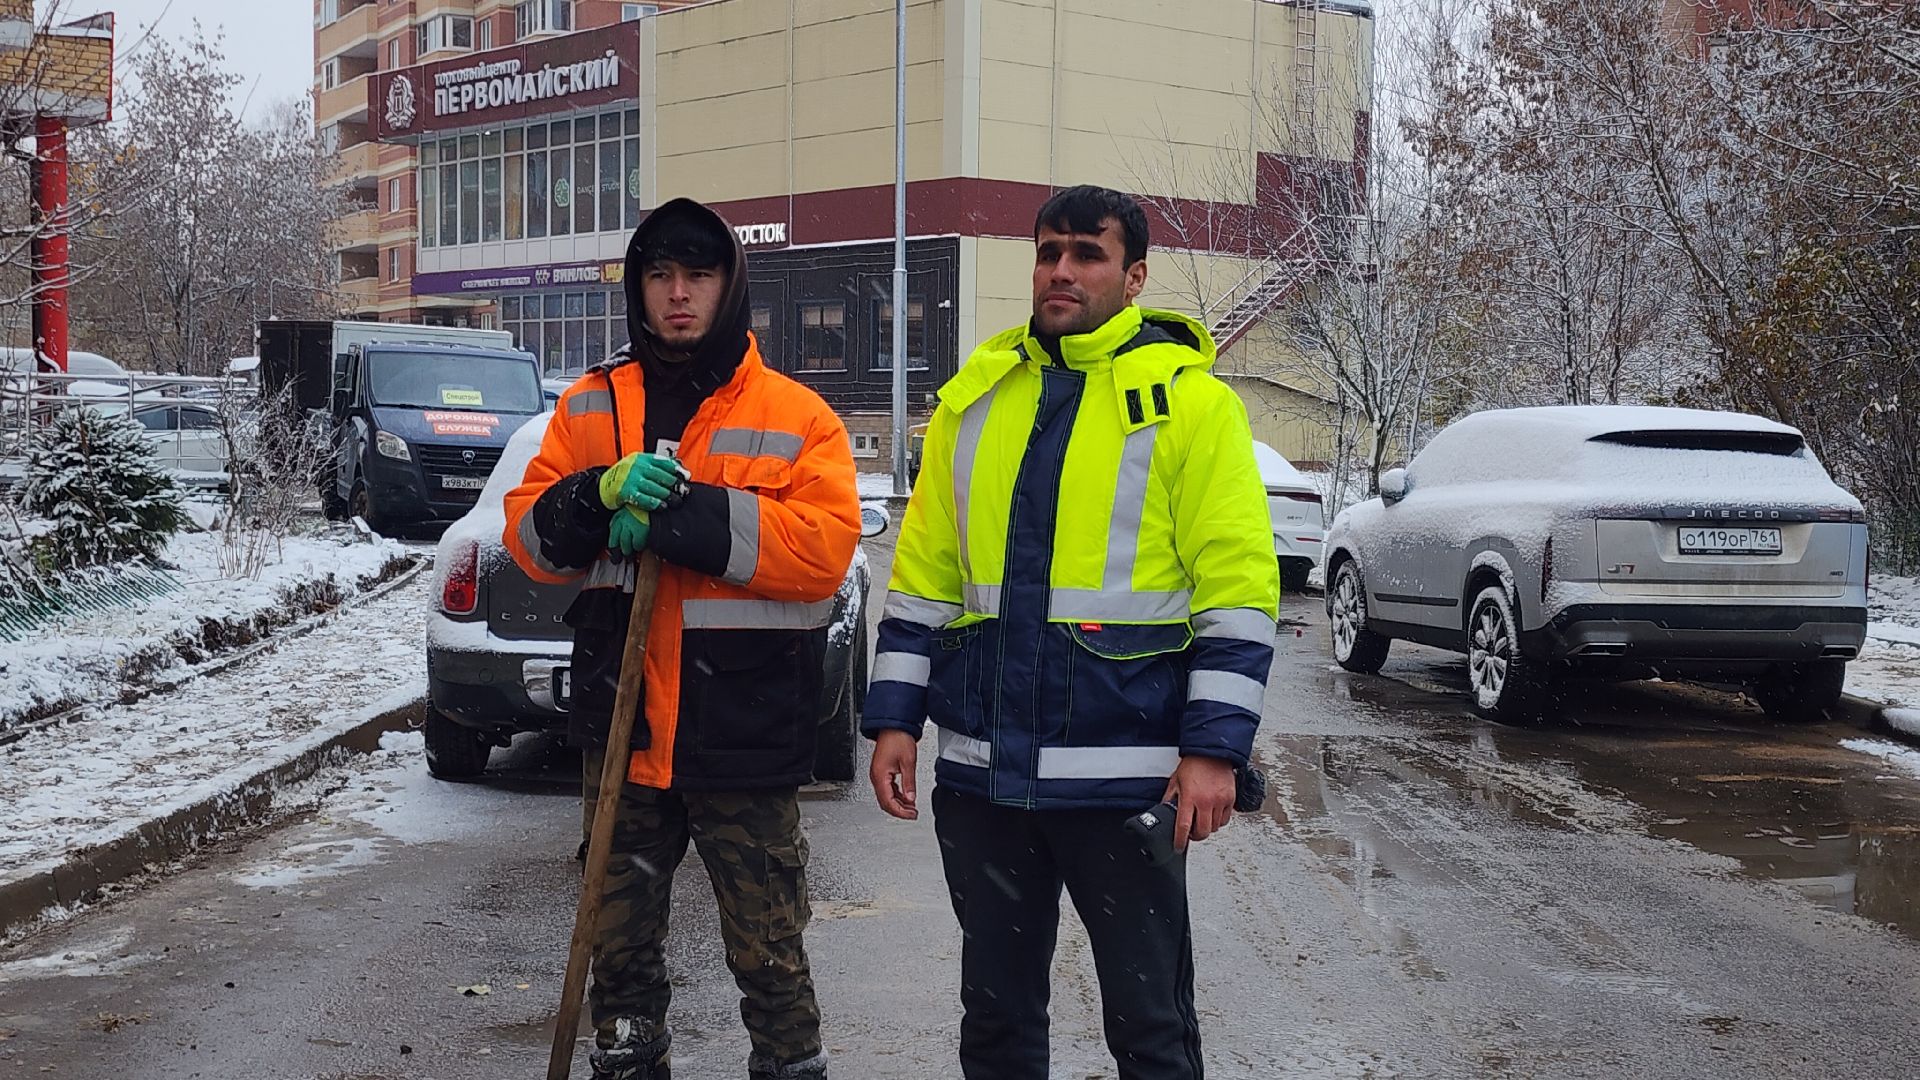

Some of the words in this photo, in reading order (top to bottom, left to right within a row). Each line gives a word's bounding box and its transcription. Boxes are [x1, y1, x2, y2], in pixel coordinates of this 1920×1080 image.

[434, 49, 620, 117] ПЕРВОМАЙСКИЙ
[733, 222, 787, 246] ОСТОК
[426, 413, 499, 424] ДОРОЖНАЯ
[437, 424, 491, 434] СЛУЖБА
[1687, 509, 1780, 519] JAECOO
[1607, 562, 1636, 575] J7
[501, 611, 563, 623] COU
